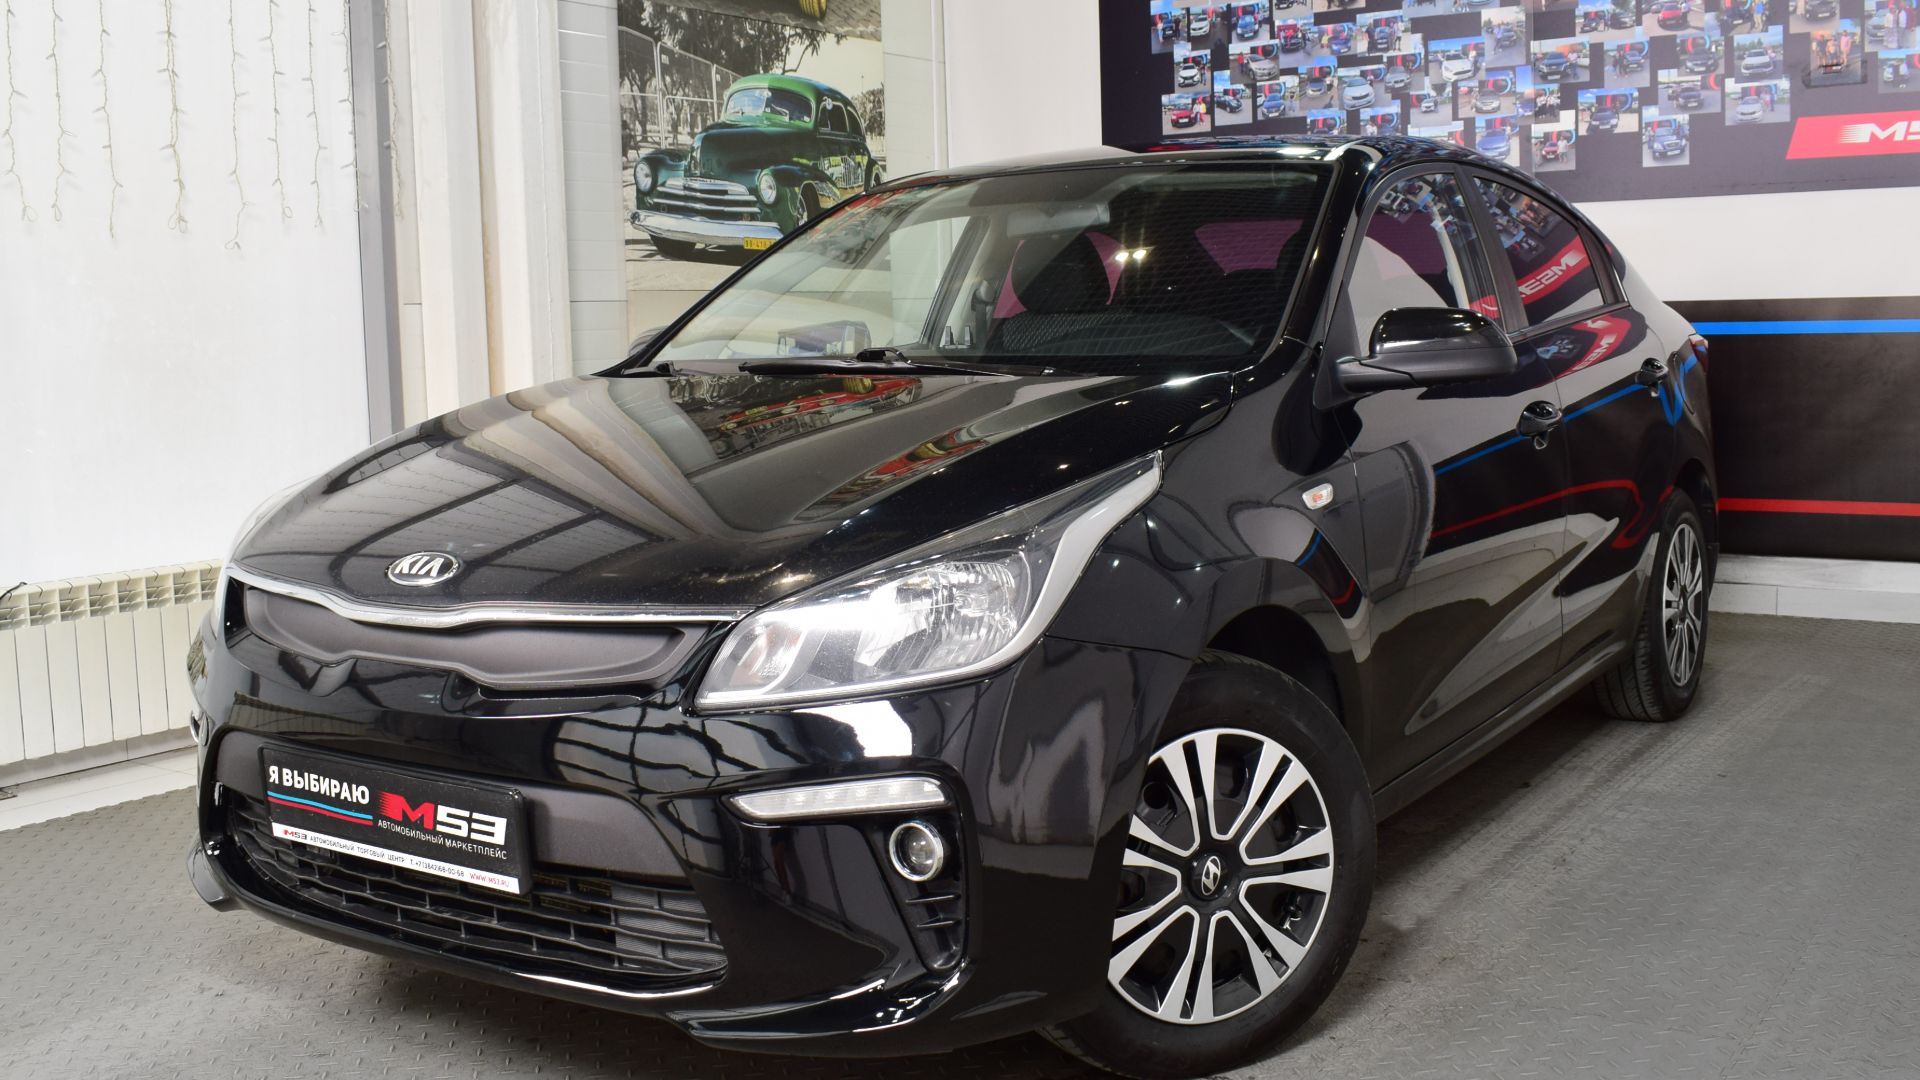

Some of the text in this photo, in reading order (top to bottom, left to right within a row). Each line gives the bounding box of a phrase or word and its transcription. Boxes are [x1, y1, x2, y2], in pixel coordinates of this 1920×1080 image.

[393, 555, 445, 577] KIA
[268, 765, 370, 805] Я ВЫБИРАЮ
[378, 790, 508, 846] M53
[282, 829, 308, 841] M53
[310, 835, 355, 852] АВТОМОБИЛЬНЫЙ
[357, 846, 386, 858] ТОРГОВЫЙ
[388, 854, 405, 863] ЦЕНТР
[377, 819, 508, 861] АВТОМОБИЛЬНЫЙ МАРКЕТПЛЕЙС
